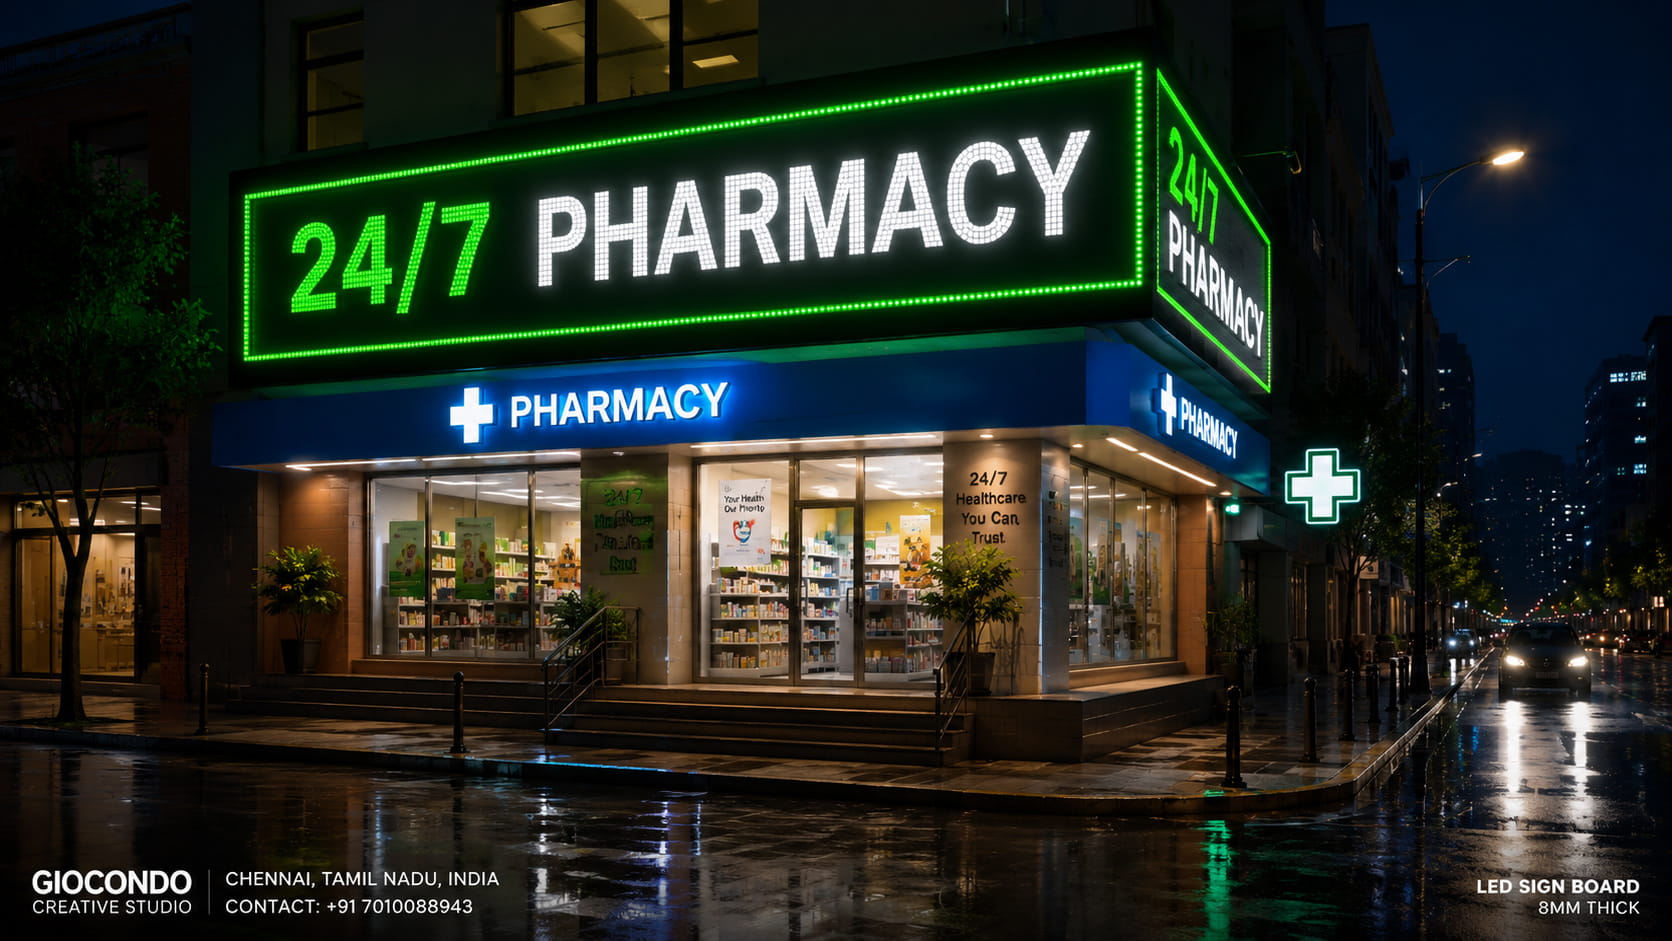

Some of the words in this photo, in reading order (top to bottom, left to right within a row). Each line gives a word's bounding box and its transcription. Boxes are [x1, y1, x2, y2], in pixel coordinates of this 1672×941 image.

[1169, 127, 1219, 244] 24/7
[291, 202, 490, 314] 24/7
[538, 130, 1091, 287] PHARMACY
[1168, 210, 1264, 358] PHARMACY
[511, 381, 729, 428] PHARMACY
[1181, 397, 1239, 459] PHARMACY
[956, 492, 1026, 505] Healthcare
[970, 470, 1008, 486] 24/7
[961, 512, 986, 525] You
